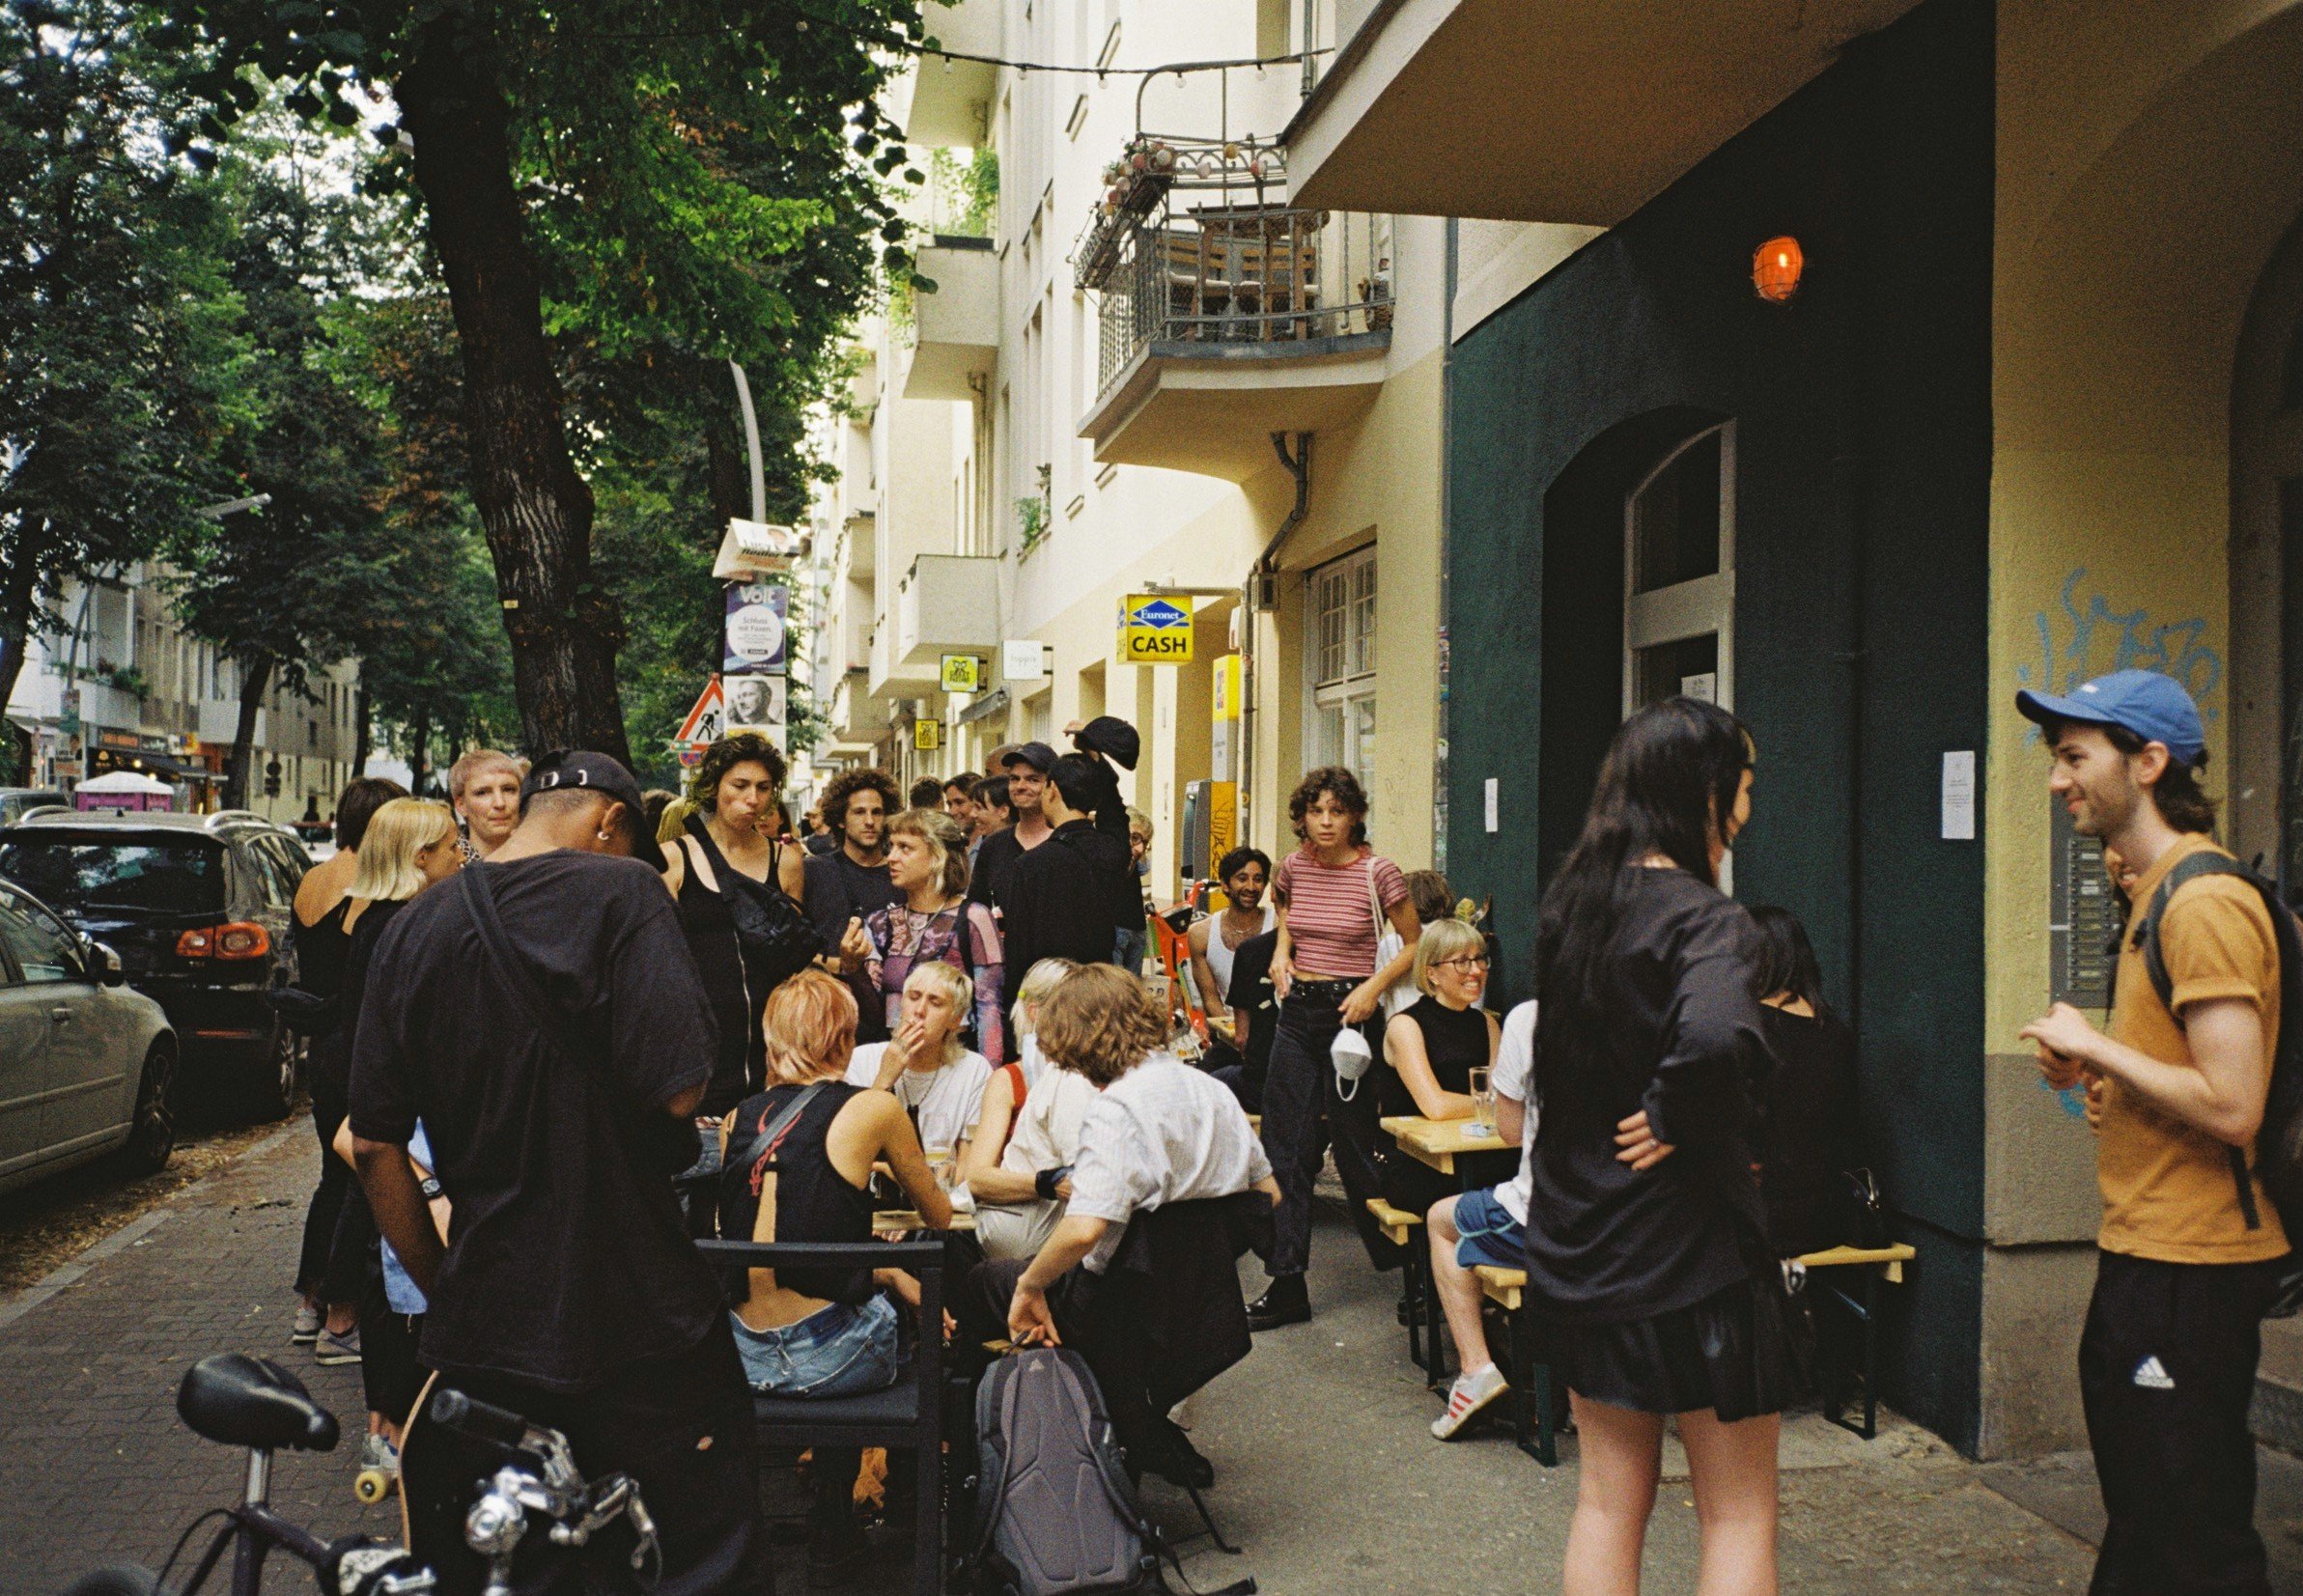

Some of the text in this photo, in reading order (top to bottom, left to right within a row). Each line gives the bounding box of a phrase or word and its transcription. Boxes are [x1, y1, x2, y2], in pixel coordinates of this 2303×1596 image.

[739, 585, 776, 604] Volt
[1140, 608, 1179, 620] Euronet
[1132, 635, 1187, 654] CASH
